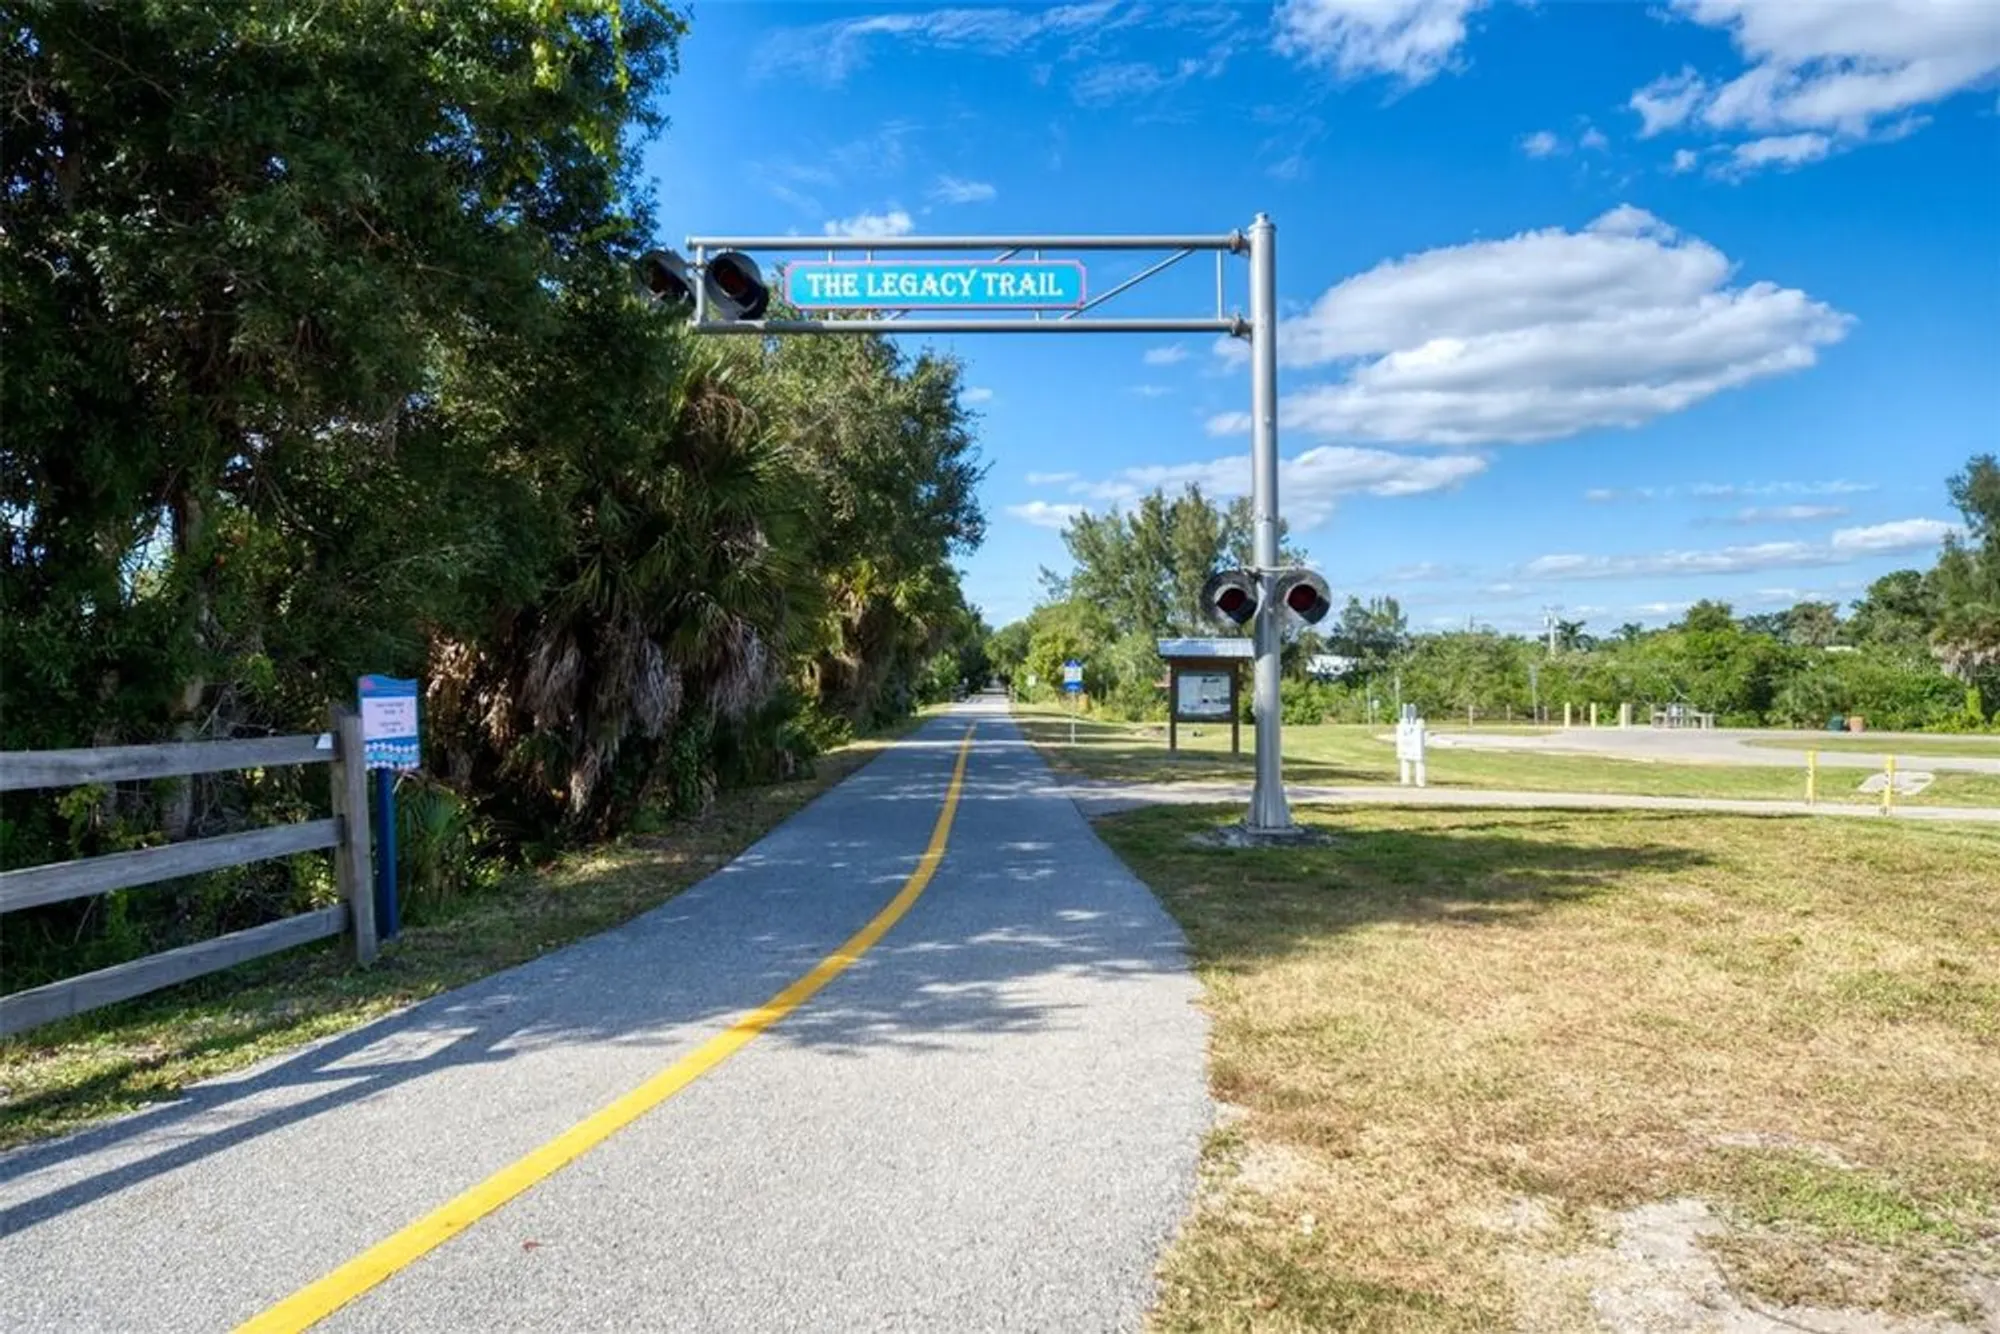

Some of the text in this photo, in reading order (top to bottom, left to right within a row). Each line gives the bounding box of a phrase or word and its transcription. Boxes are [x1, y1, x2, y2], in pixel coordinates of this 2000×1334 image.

[806, 268, 1063, 297] THE LEGACY TRAIL
